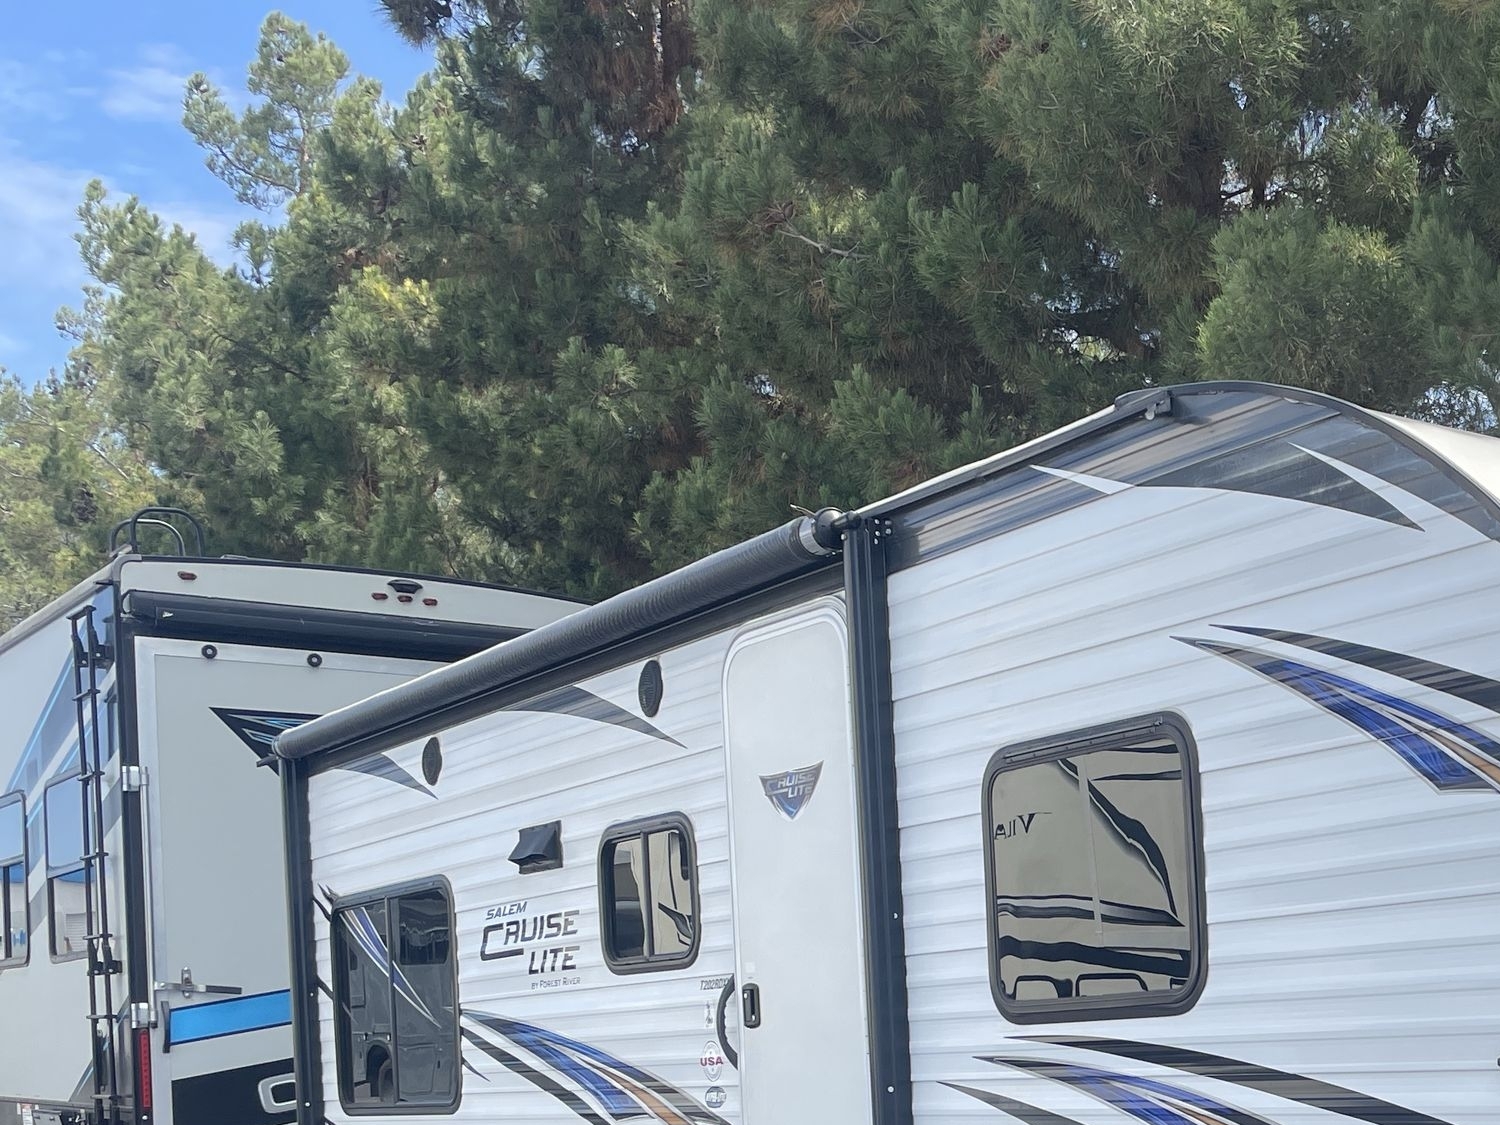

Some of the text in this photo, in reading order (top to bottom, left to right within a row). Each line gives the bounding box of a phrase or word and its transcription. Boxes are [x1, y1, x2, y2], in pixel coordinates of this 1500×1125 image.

[485, 901, 527, 920] SALEM
[480, 909, 580, 961] CRUISE
[528, 945, 580, 975] LITE
[700, 1056, 723, 1067] USA
